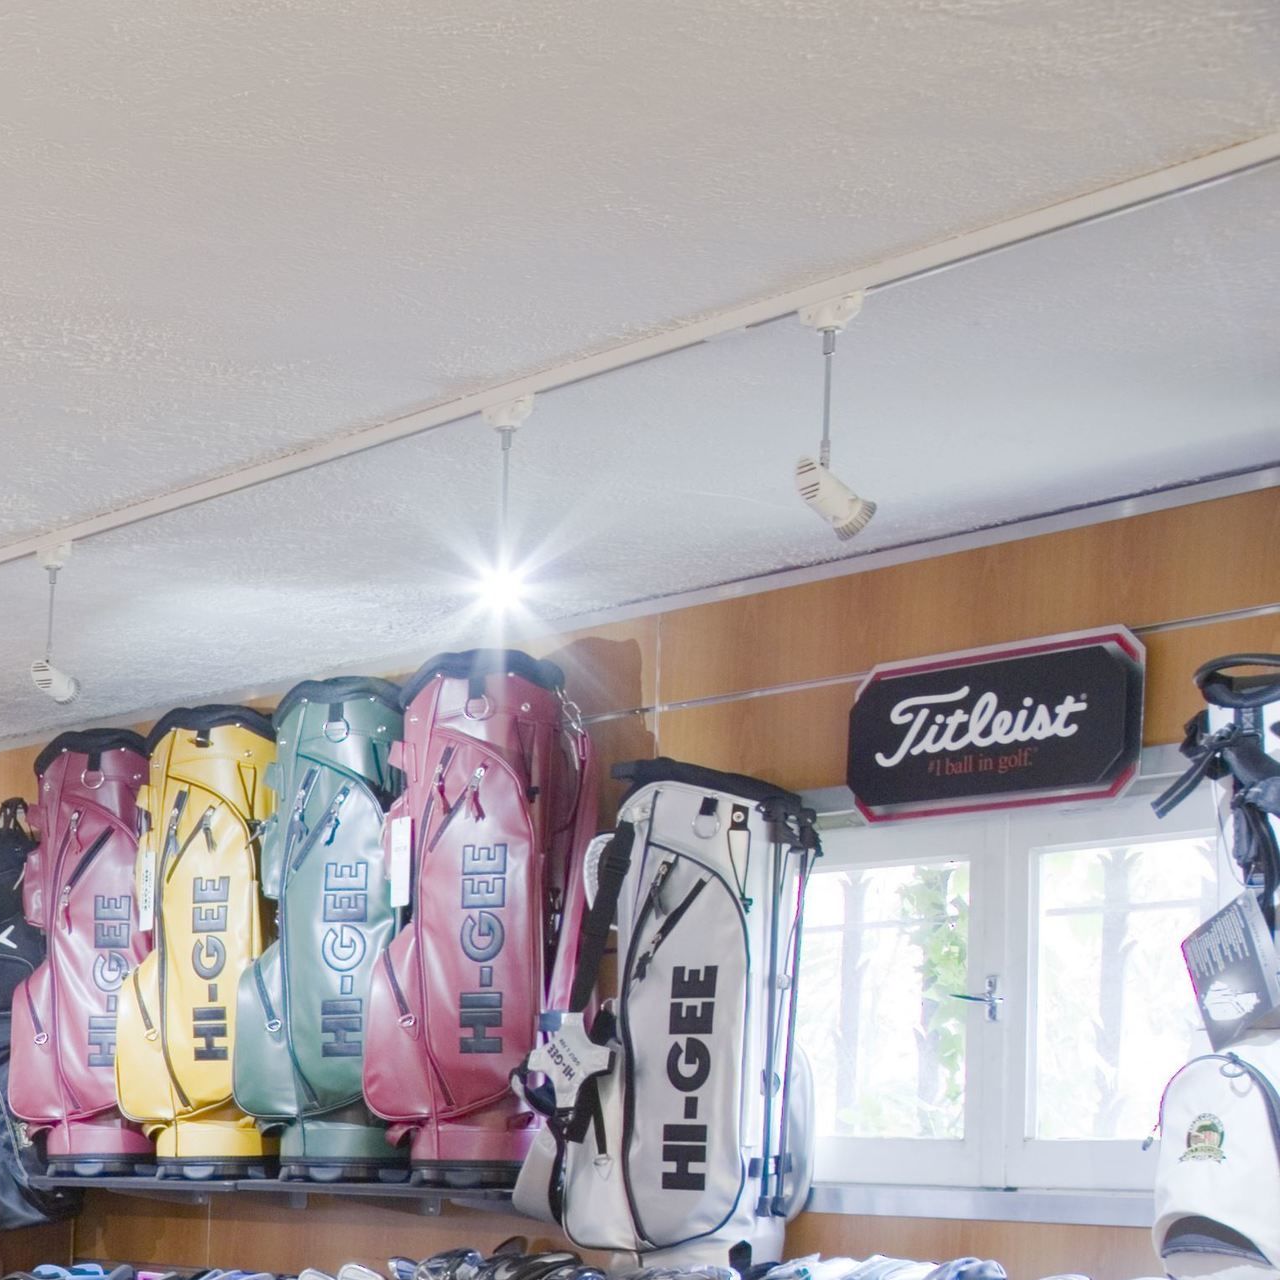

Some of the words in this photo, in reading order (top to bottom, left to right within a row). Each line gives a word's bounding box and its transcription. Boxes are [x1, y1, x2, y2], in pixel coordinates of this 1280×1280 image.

[875, 686, 1081, 768] Titleist
[945, 754, 973, 776] ball
[979, 753, 993, 771] in
[87, 895, 131, 1067] HI-GEE
[192, 876, 231, 1061] HI-GEE
[321, 861, 369, 1058] HI-GEE
[459, 843, 508, 1054] HI-GEE
[547, 1043, 576, 1081] HI-GEE
[661, 964, 719, 1191] HI-GEE
